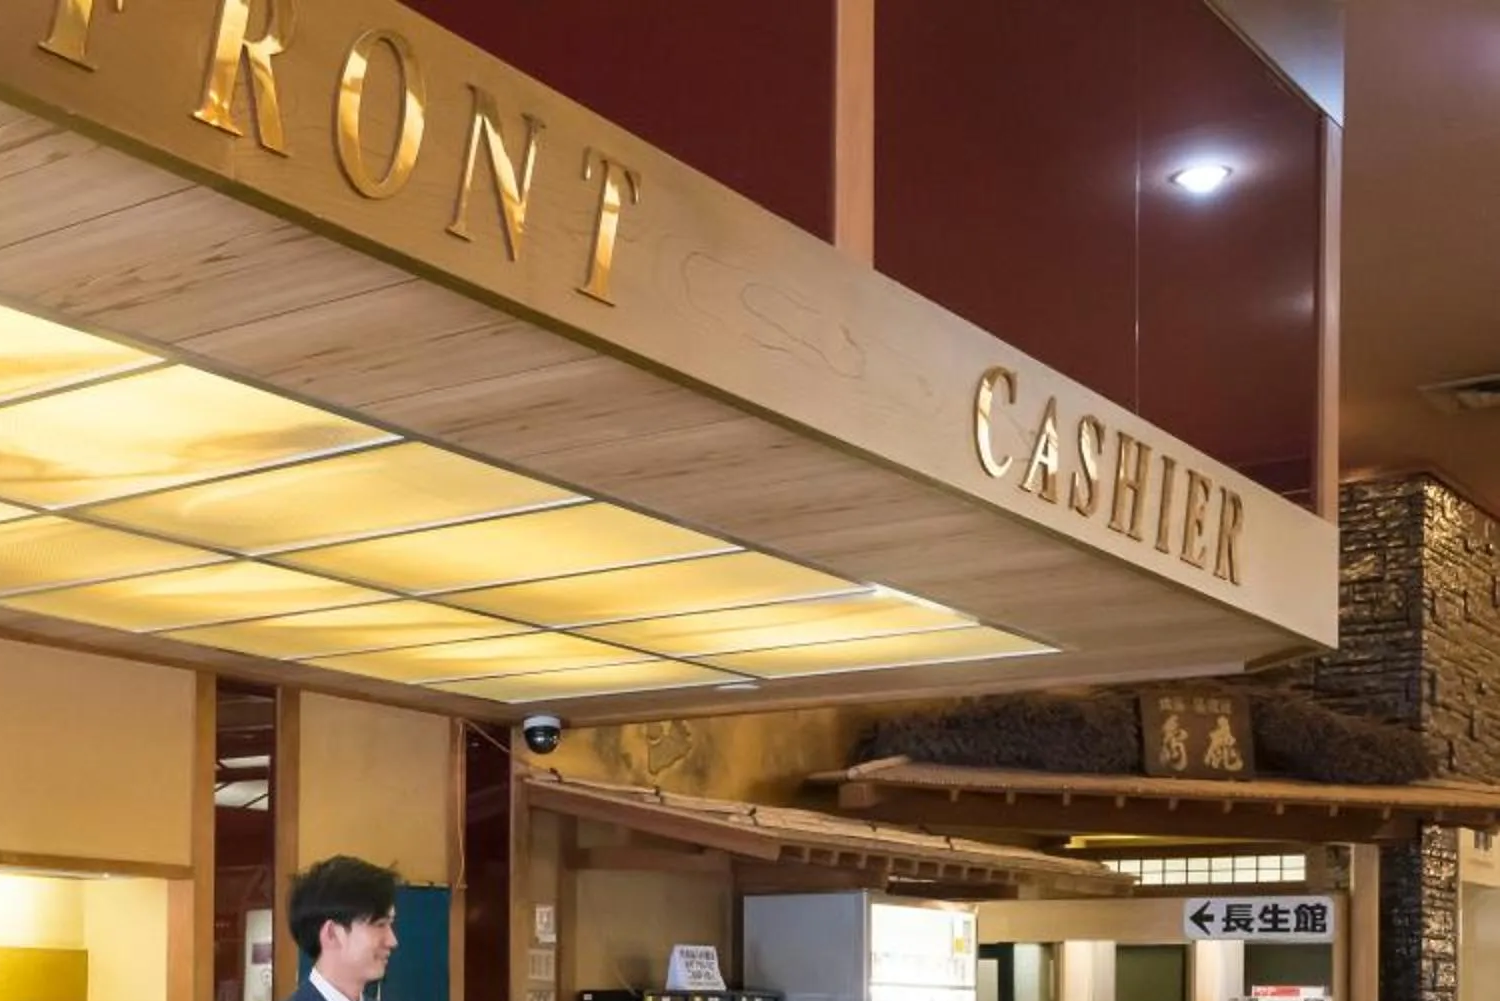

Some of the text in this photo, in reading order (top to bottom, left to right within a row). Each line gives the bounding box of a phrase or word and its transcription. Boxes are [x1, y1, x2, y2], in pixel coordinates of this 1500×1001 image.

[974, 366, 1246, 585] CASHIER
[1221, 902, 1328, 934] 長生館
